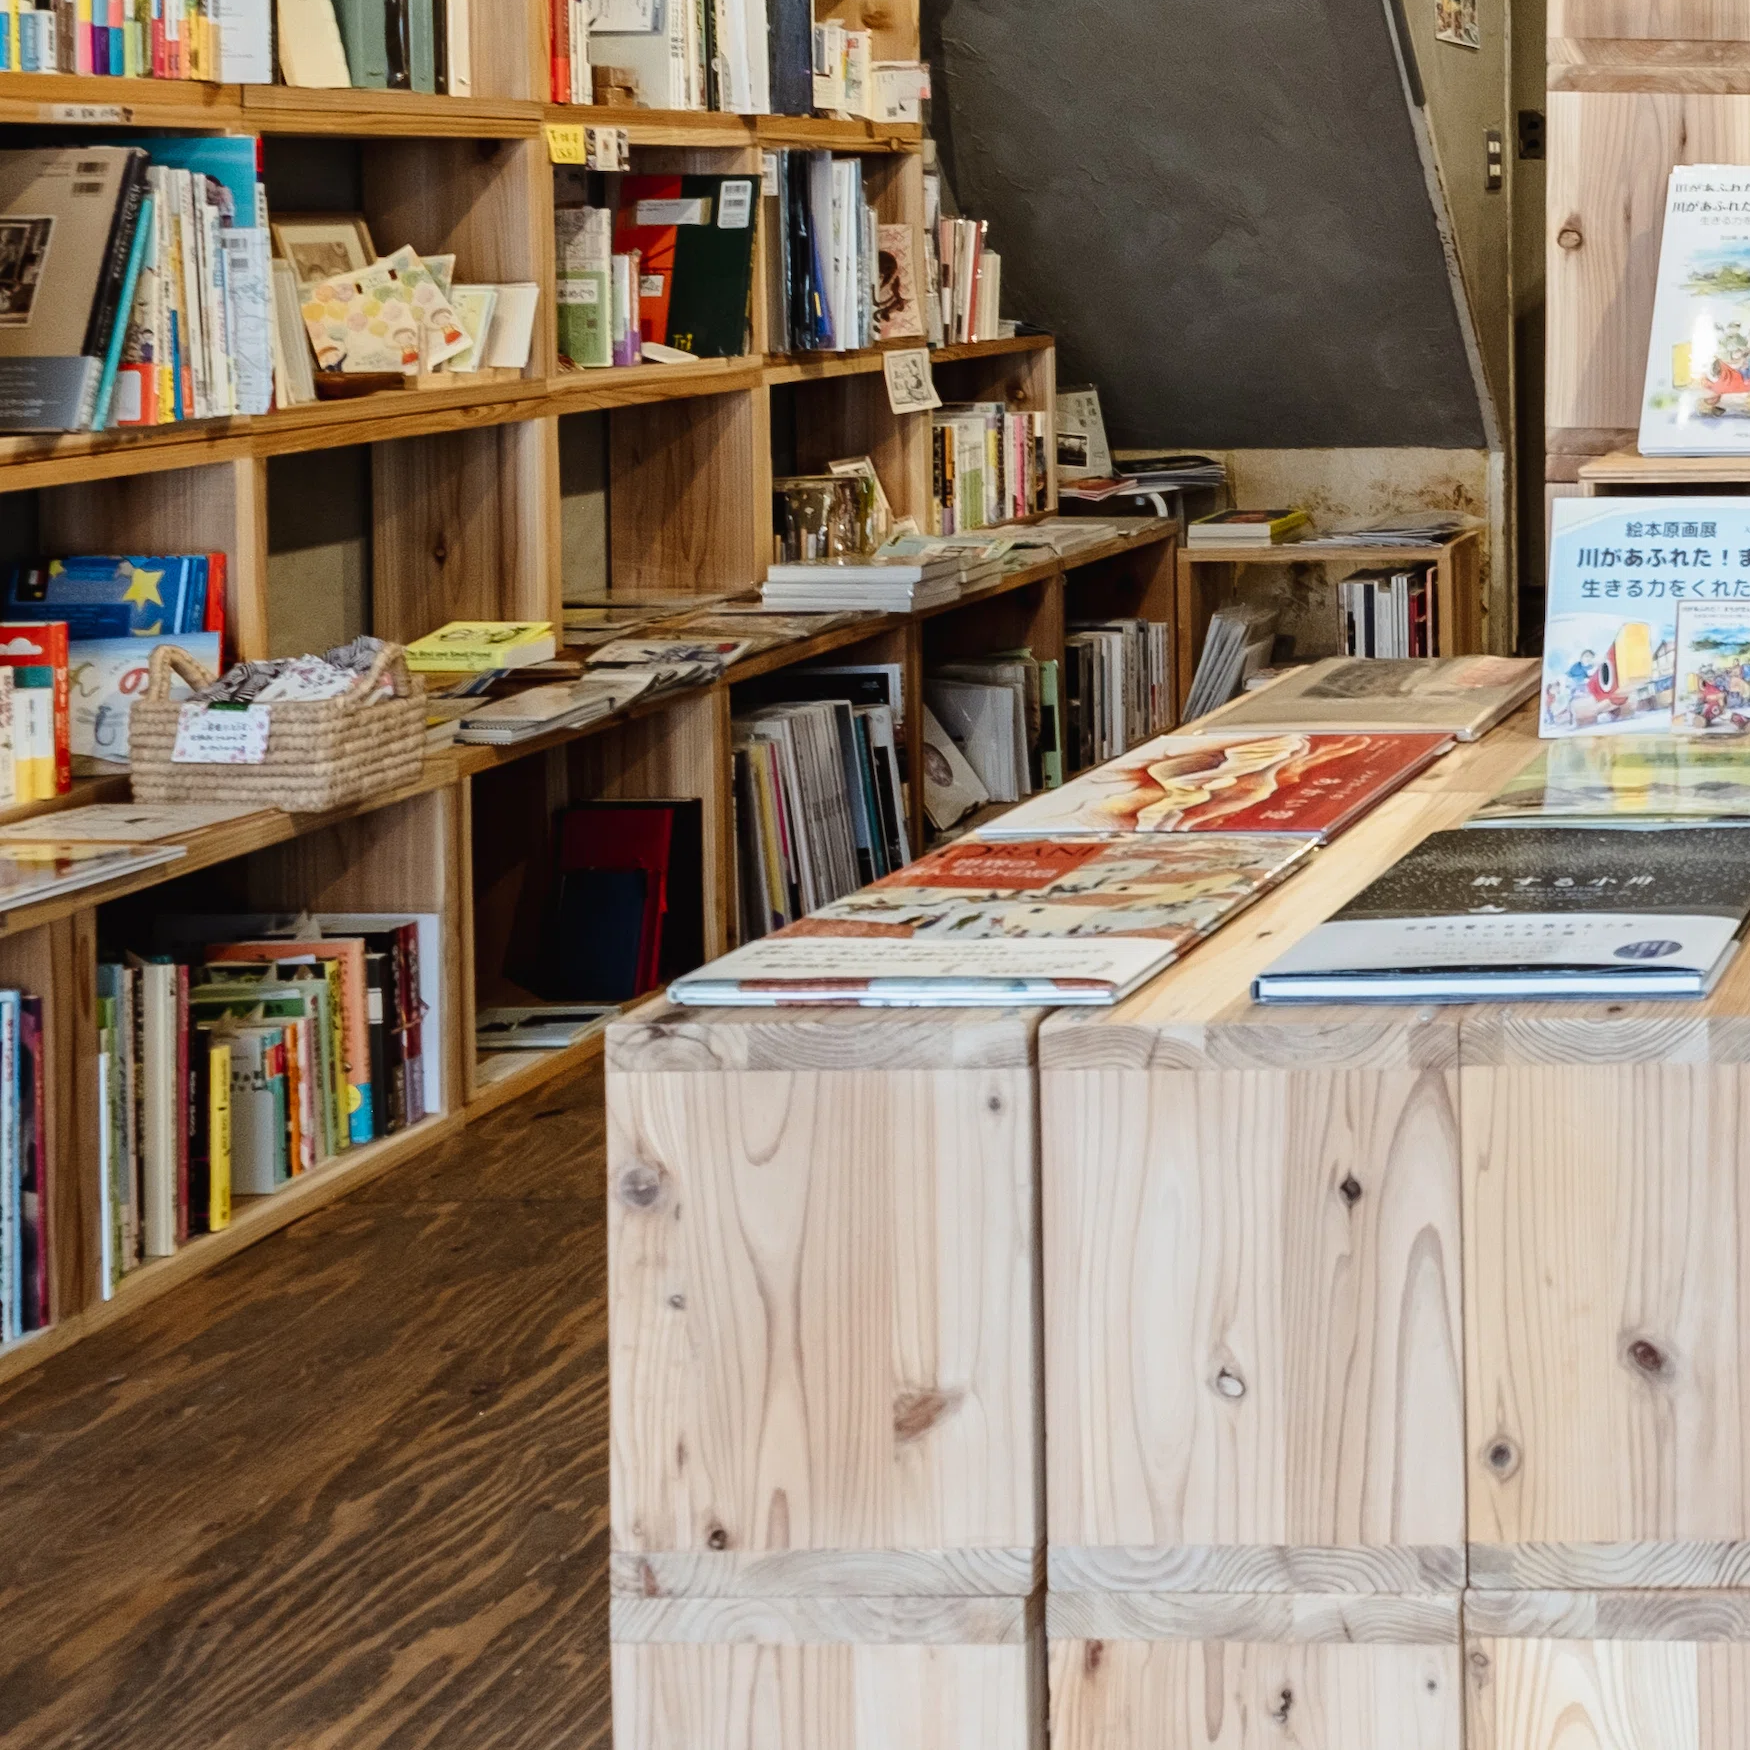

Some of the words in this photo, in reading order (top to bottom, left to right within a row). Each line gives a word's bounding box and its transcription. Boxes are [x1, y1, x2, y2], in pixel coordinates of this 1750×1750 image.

[1625, 521, 1718, 539] 絵本原画展
